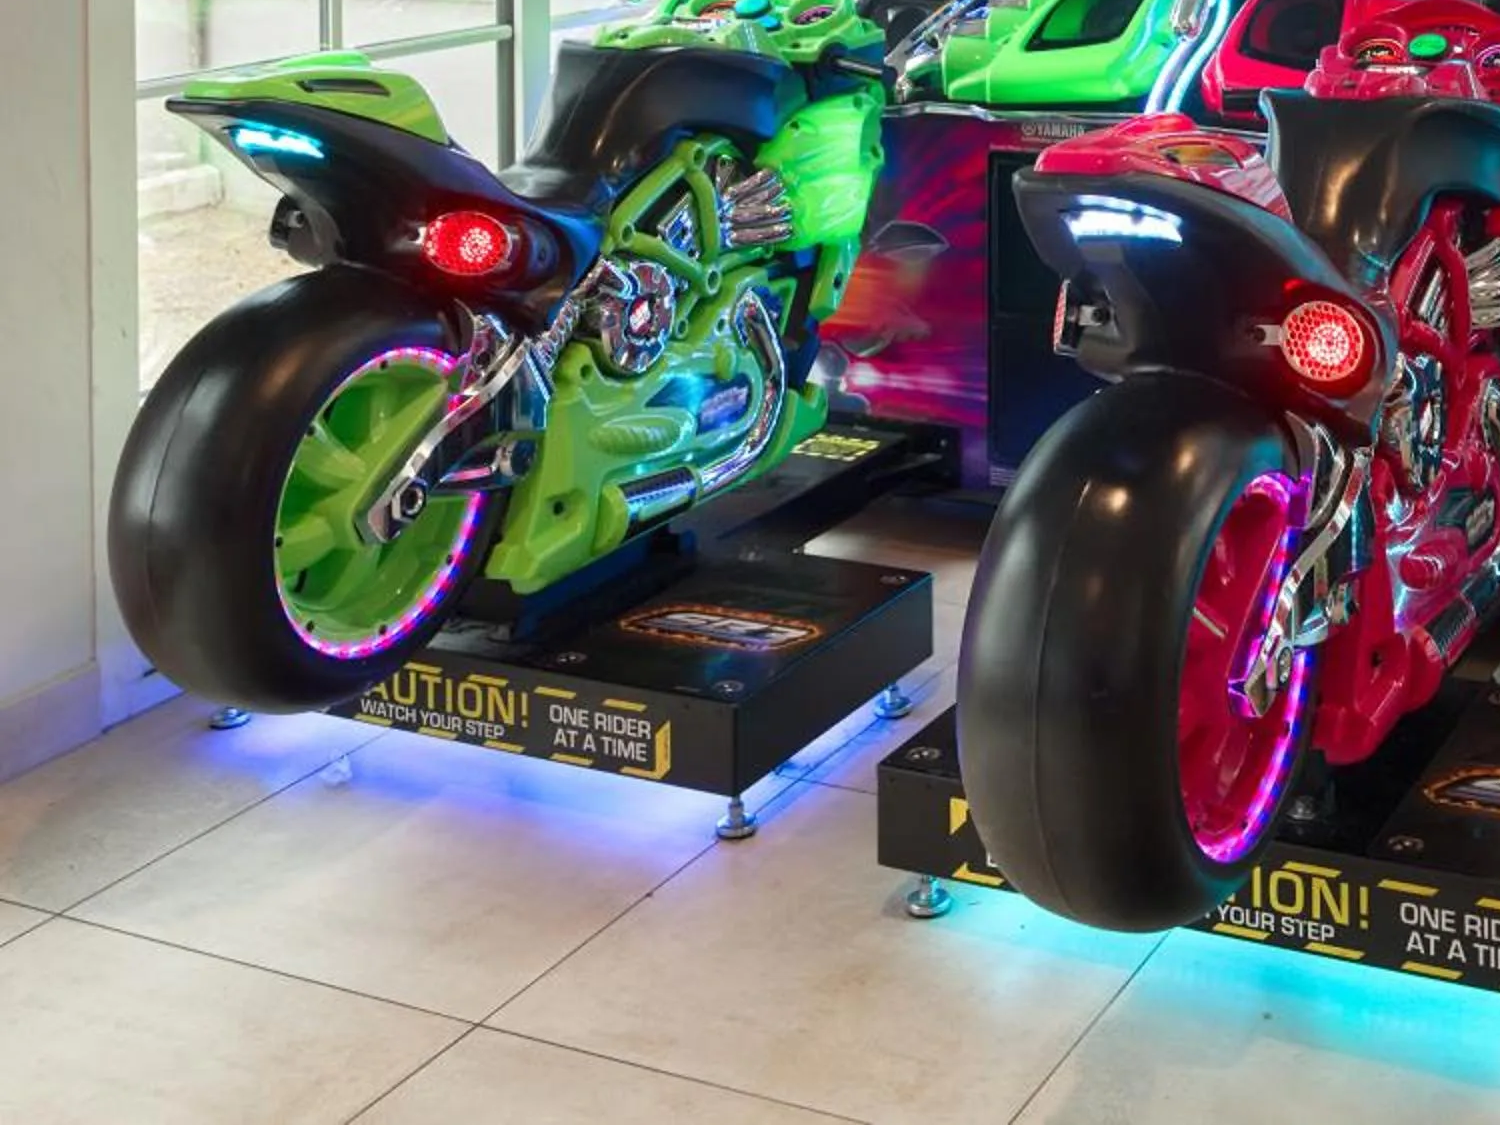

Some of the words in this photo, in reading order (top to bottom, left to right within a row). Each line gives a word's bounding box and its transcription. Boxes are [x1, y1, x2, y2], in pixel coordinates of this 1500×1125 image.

[360, 698, 417, 723] WATCH
[419, 710, 463, 732] YOUR
[465, 720, 505, 739] STEP
[549, 704, 589, 729] ONE
[594, 712, 652, 740] RIDER
[553, 728, 579, 748] AT
[583, 733, 597, 752] A
[600, 736, 648, 762] TIME
[1217, 904, 1276, 932] YOUR
[1280, 917, 1335, 942] STEP
[1400, 902, 1457, 933] ONE
[1405, 930, 1441, 957] AT
[1447, 938, 1467, 964] A
